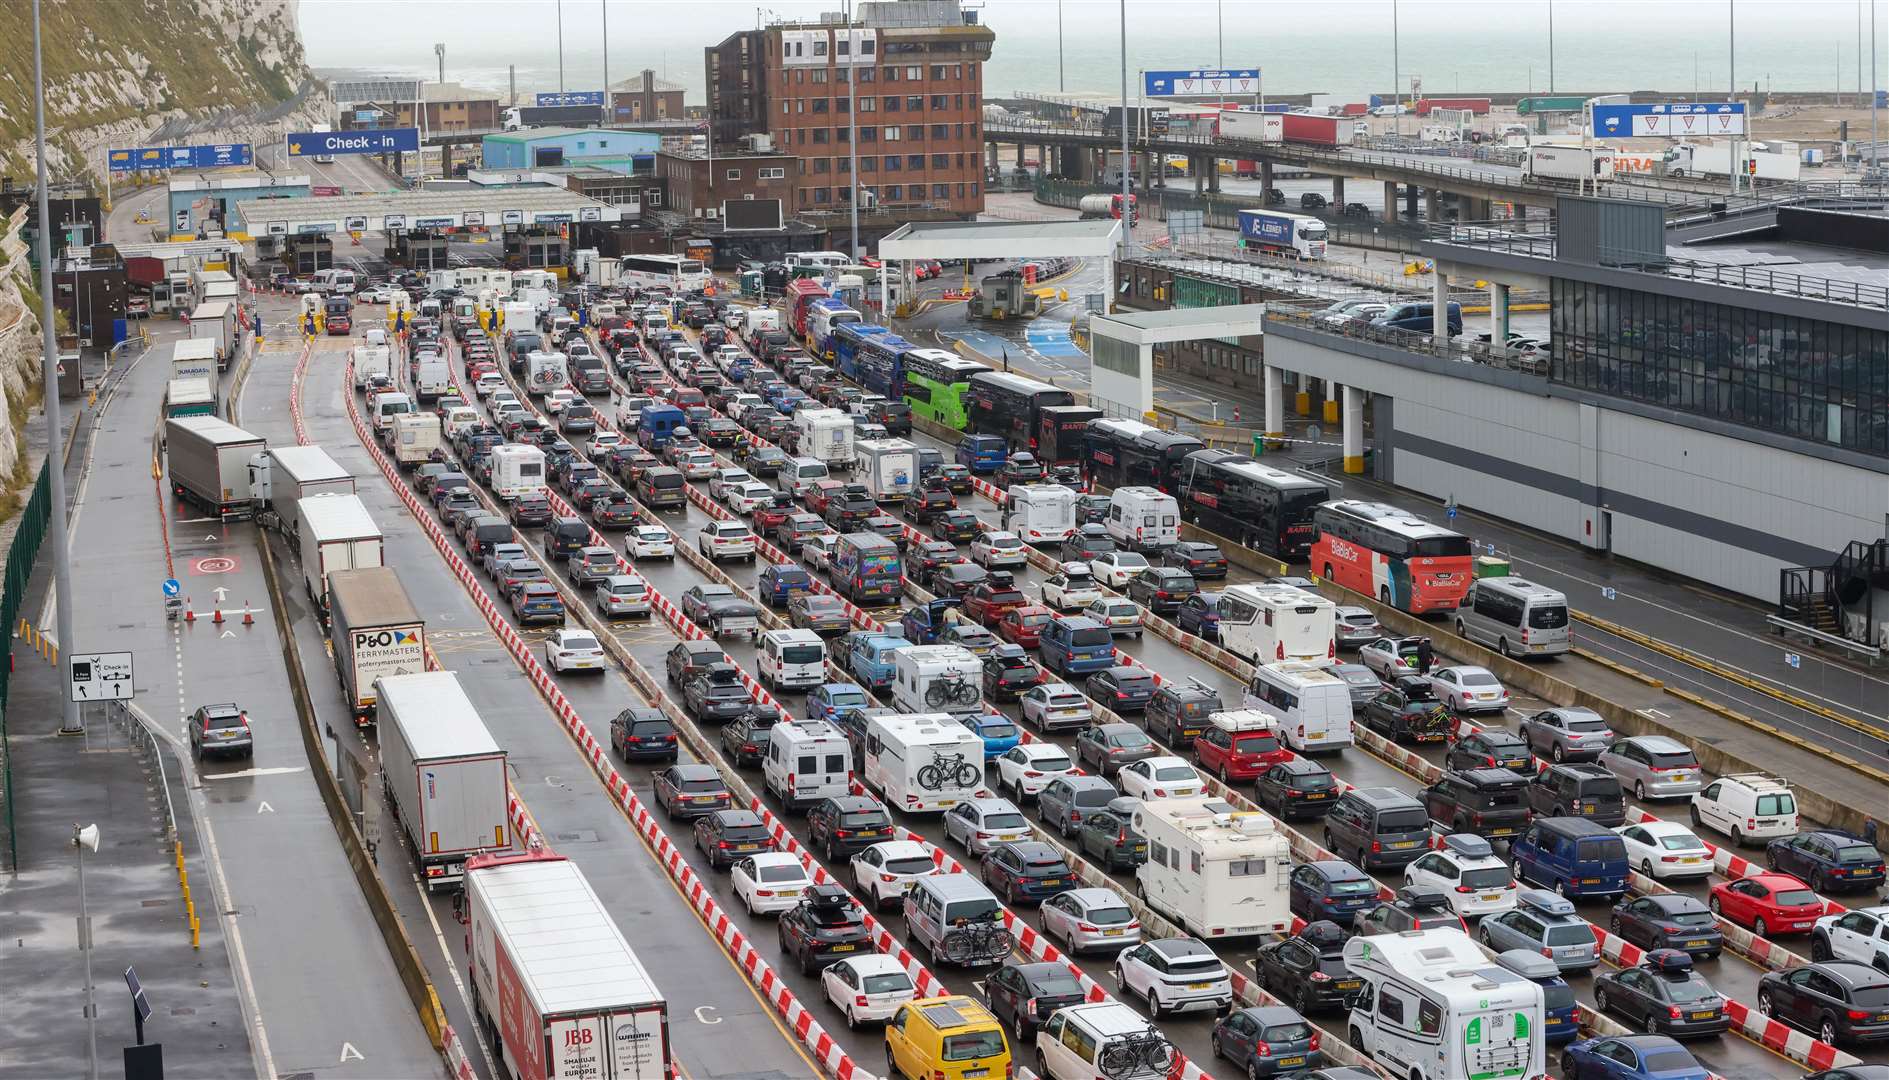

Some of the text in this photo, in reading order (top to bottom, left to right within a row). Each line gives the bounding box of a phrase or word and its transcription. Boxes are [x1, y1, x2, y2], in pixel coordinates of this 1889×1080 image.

[325, 136, 369, 150] Check
[382, 135, 395, 147] in
[270, 177, 276, 186] 2
[516, 174, 522, 182] 3
[1331, 538, 1359, 562] BlaBlaCar
[1432, 579, 1462, 587] BlaBlaCar
[356, 631, 392, 649] P&O
[357, 646, 420, 659] FERRYMASTERS
[358, 657, 421, 669] poferrymasters.com
[257, 800, 275, 814] A
[693, 1005, 723, 1025] C
[565, 1028, 593, 1048] JBB
[339, 1041, 365, 1062] A
[563, 1056, 597, 1065] SMAKUJE
[564, 1068, 597, 1077] EUROPIE
